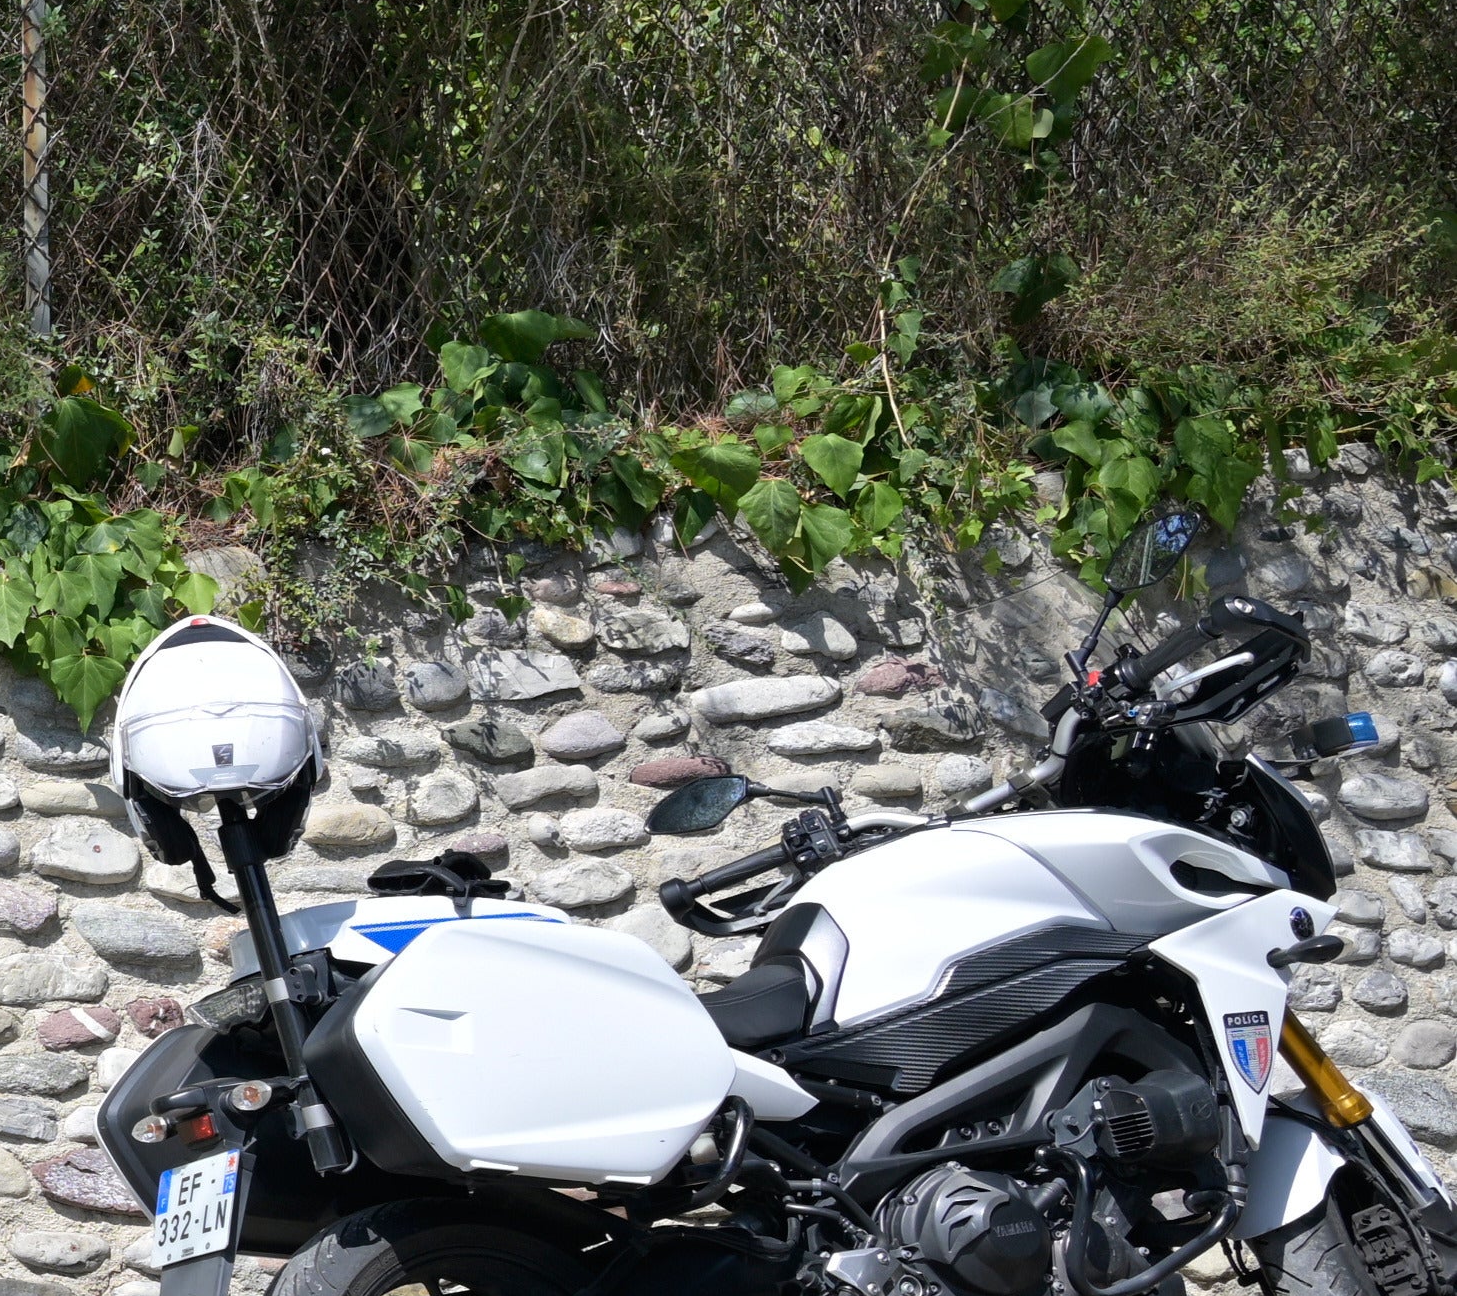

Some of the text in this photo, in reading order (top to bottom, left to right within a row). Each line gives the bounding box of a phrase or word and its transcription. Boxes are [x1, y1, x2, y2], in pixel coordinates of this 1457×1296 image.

[1227, 1014, 1265, 1026] POLICE
[224, 1174, 235, 1193] 75
[158, 1200, 227, 1247] 332-LN
[994, 1220, 1037, 1238] YAMAHA
